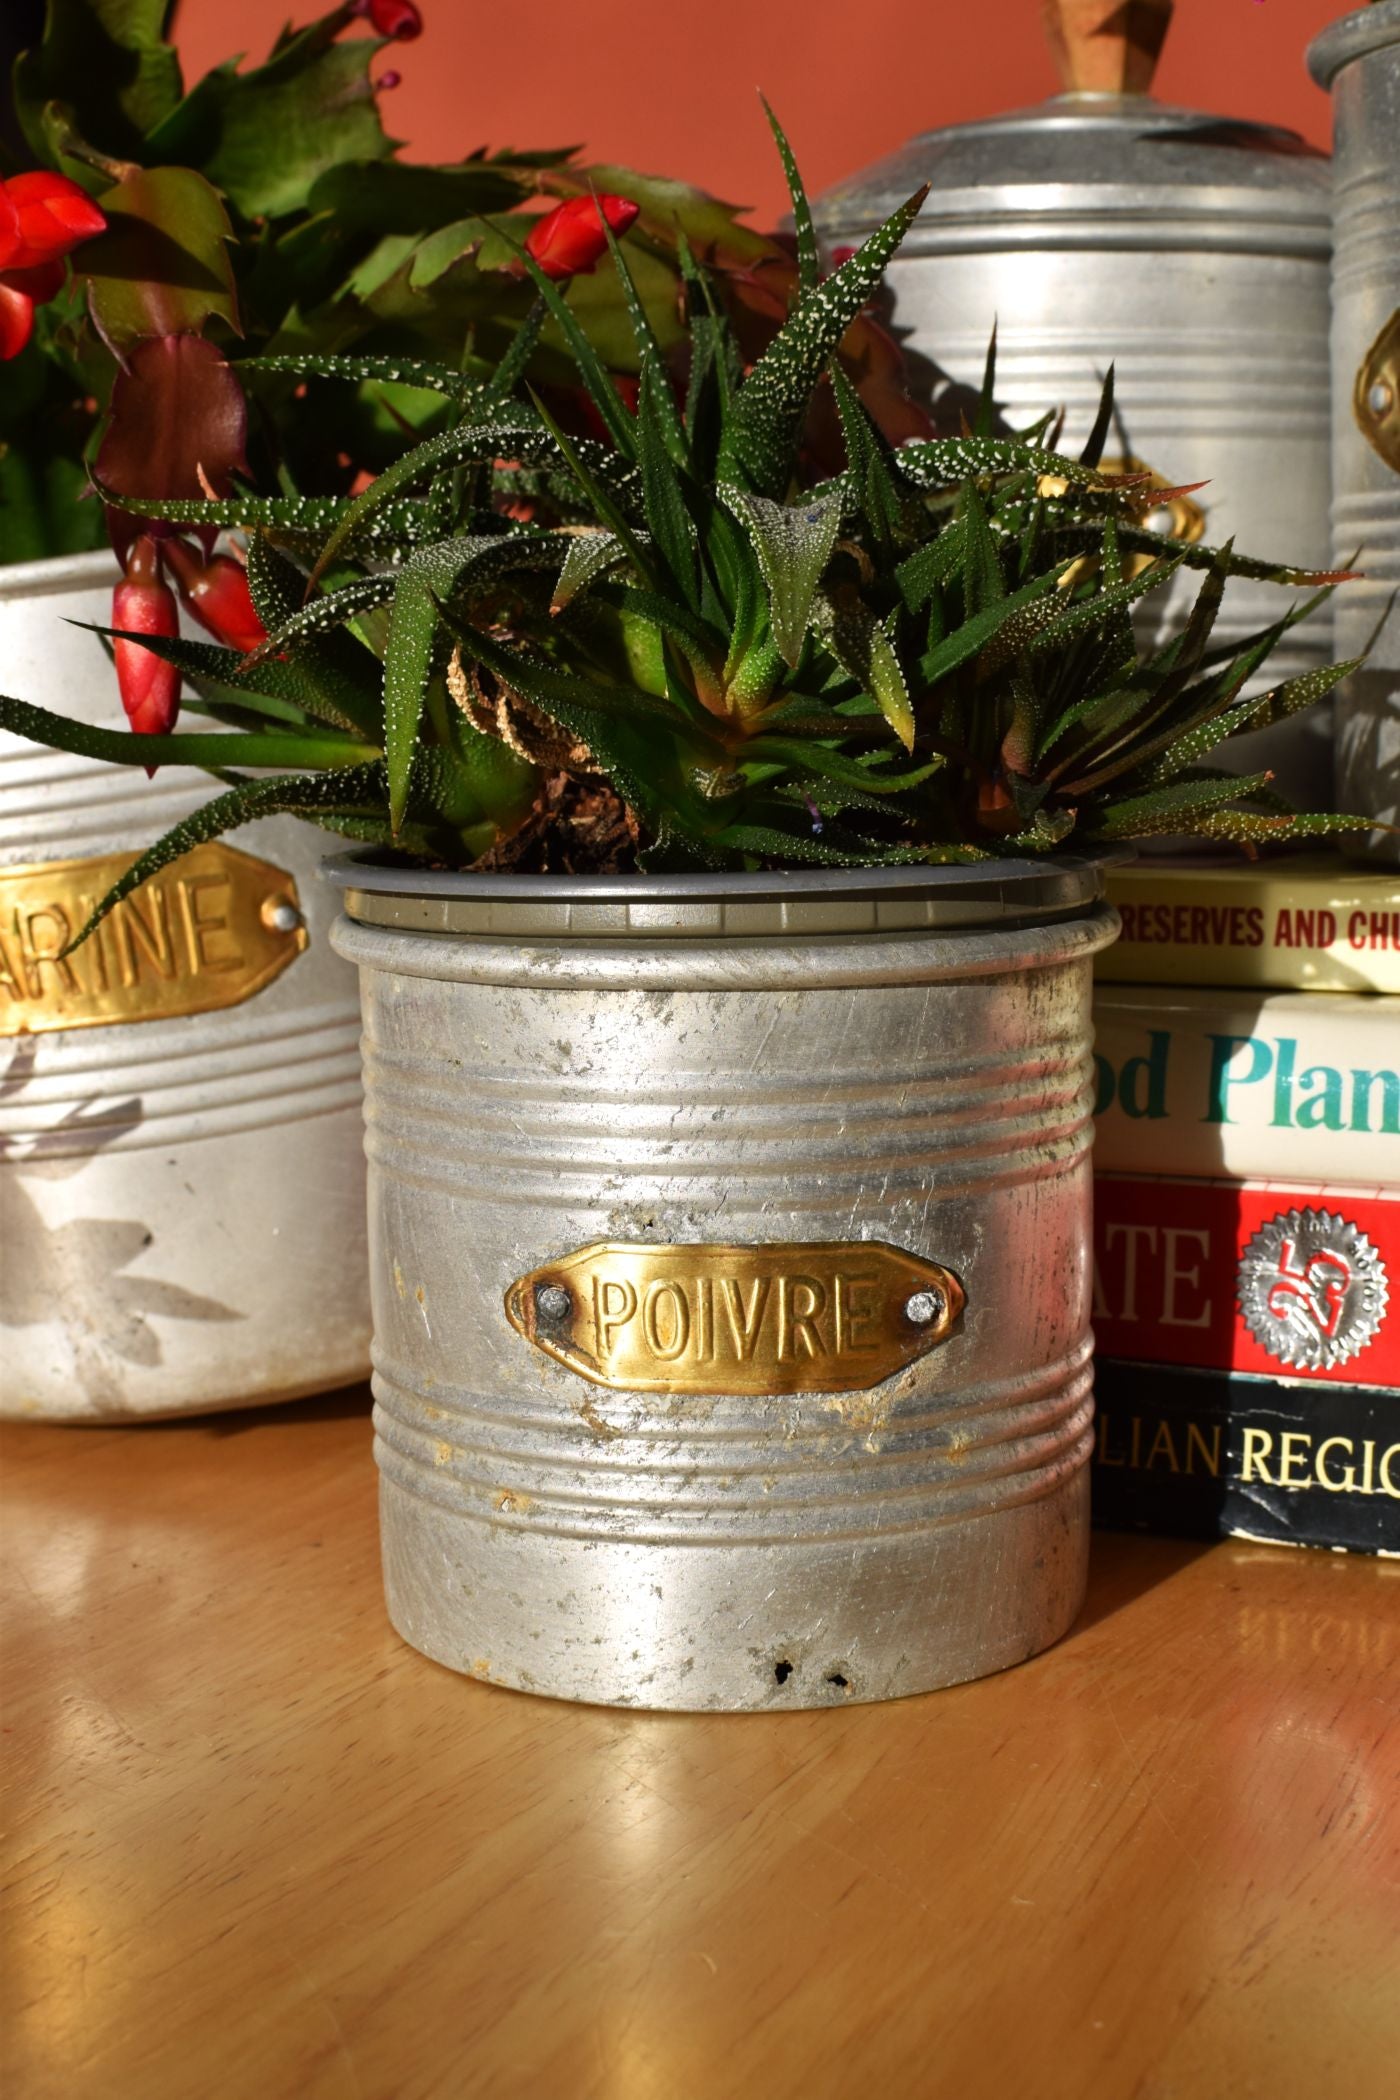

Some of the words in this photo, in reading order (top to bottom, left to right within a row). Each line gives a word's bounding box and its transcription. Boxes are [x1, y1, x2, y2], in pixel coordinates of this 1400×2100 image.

[1274, 908, 1337, 949] AND
[1198, 1032, 1400, 1135] Plan
[590, 1273, 881, 1363] POIVRE
